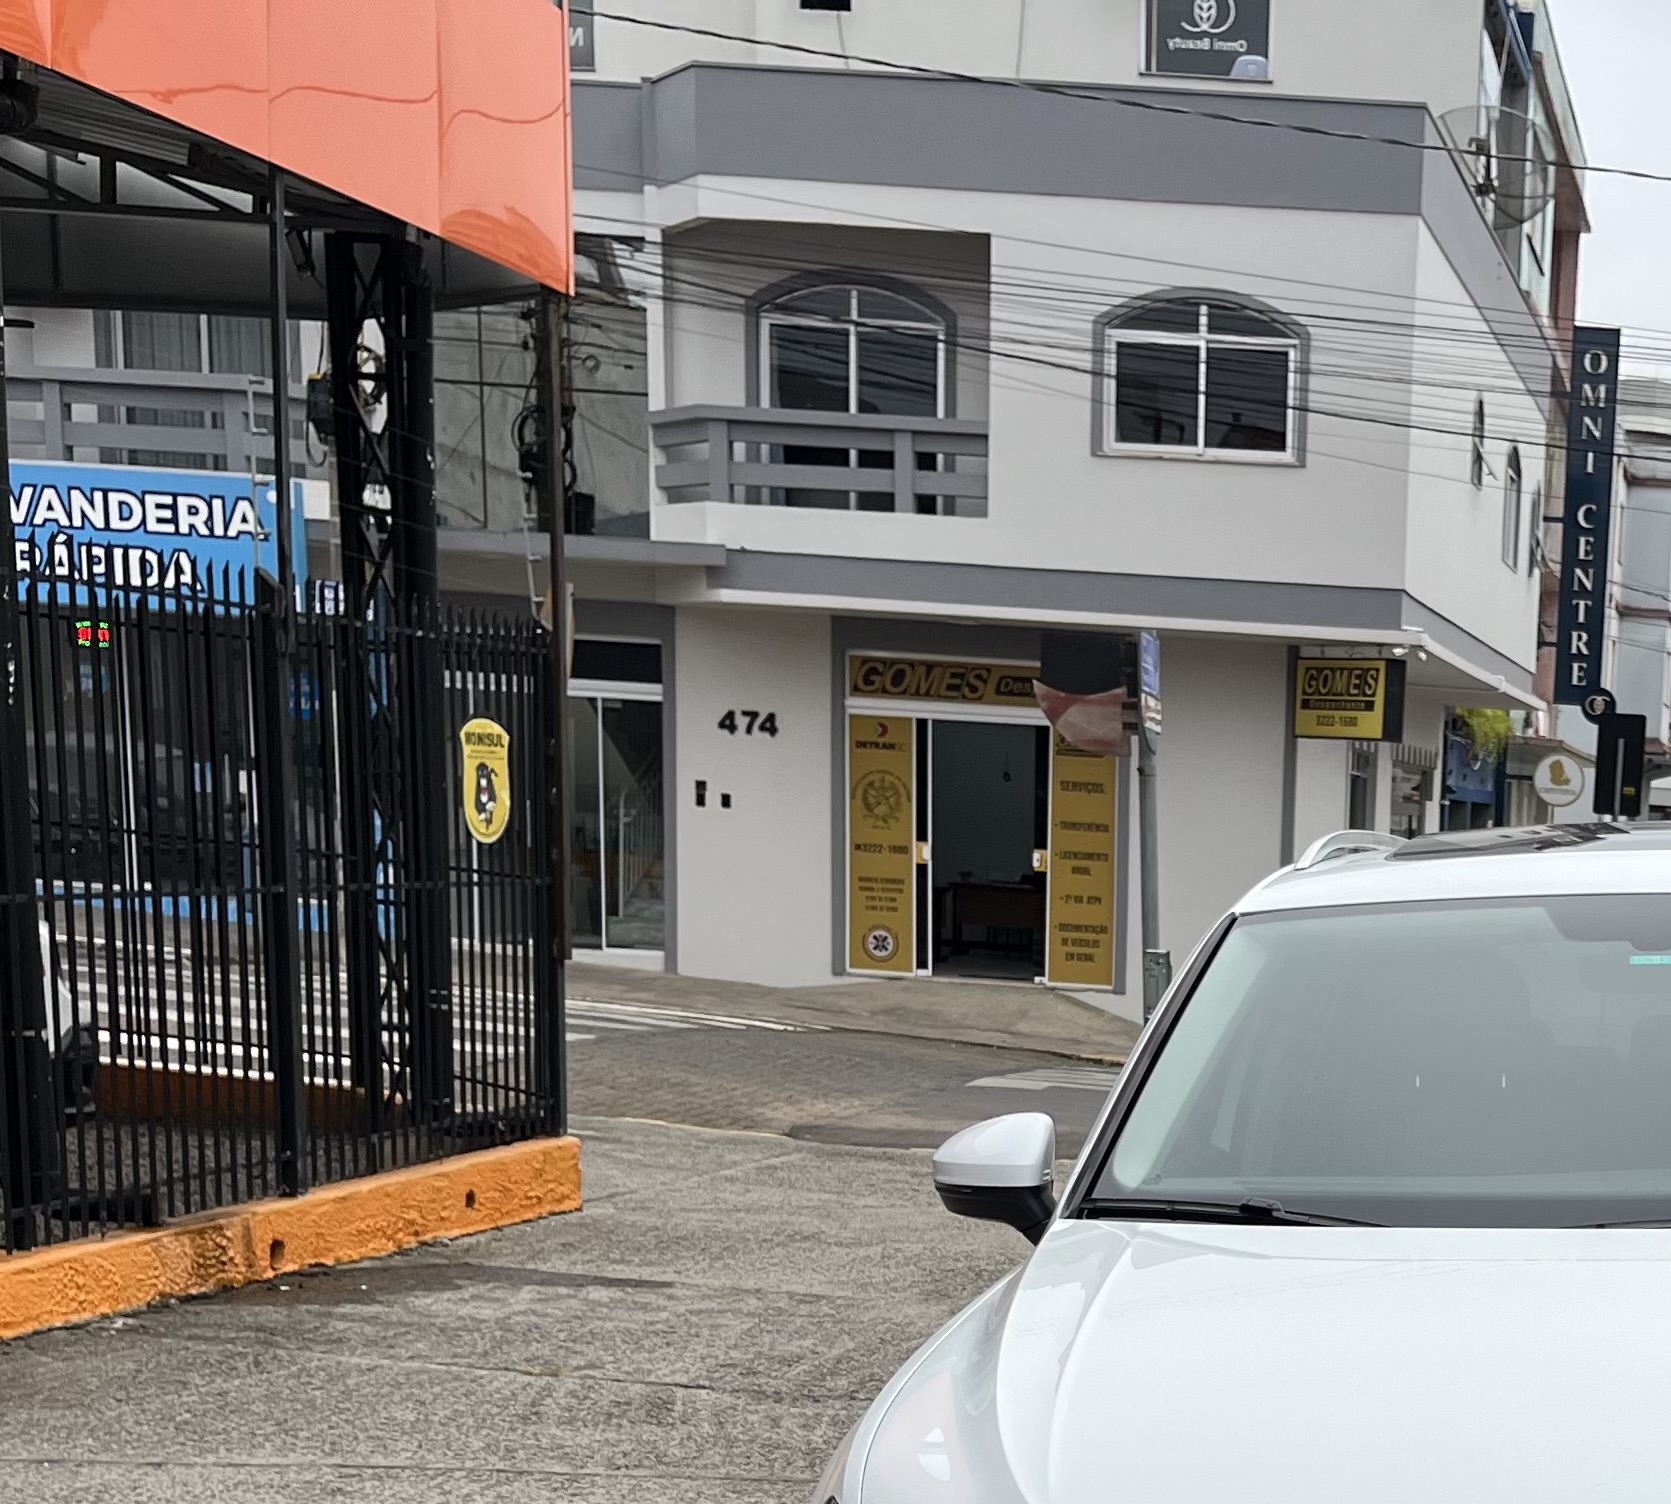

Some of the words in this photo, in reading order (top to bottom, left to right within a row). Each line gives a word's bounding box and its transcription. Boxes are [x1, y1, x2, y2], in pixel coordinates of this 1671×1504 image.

[1580, 349, 1609, 474] OMNI
[1569, 504, 1598, 687] CENTRE
[856, 661, 990, 700] GOMES
[1303, 668, 1379, 696] GOMES
[717, 709, 779, 738] 474
